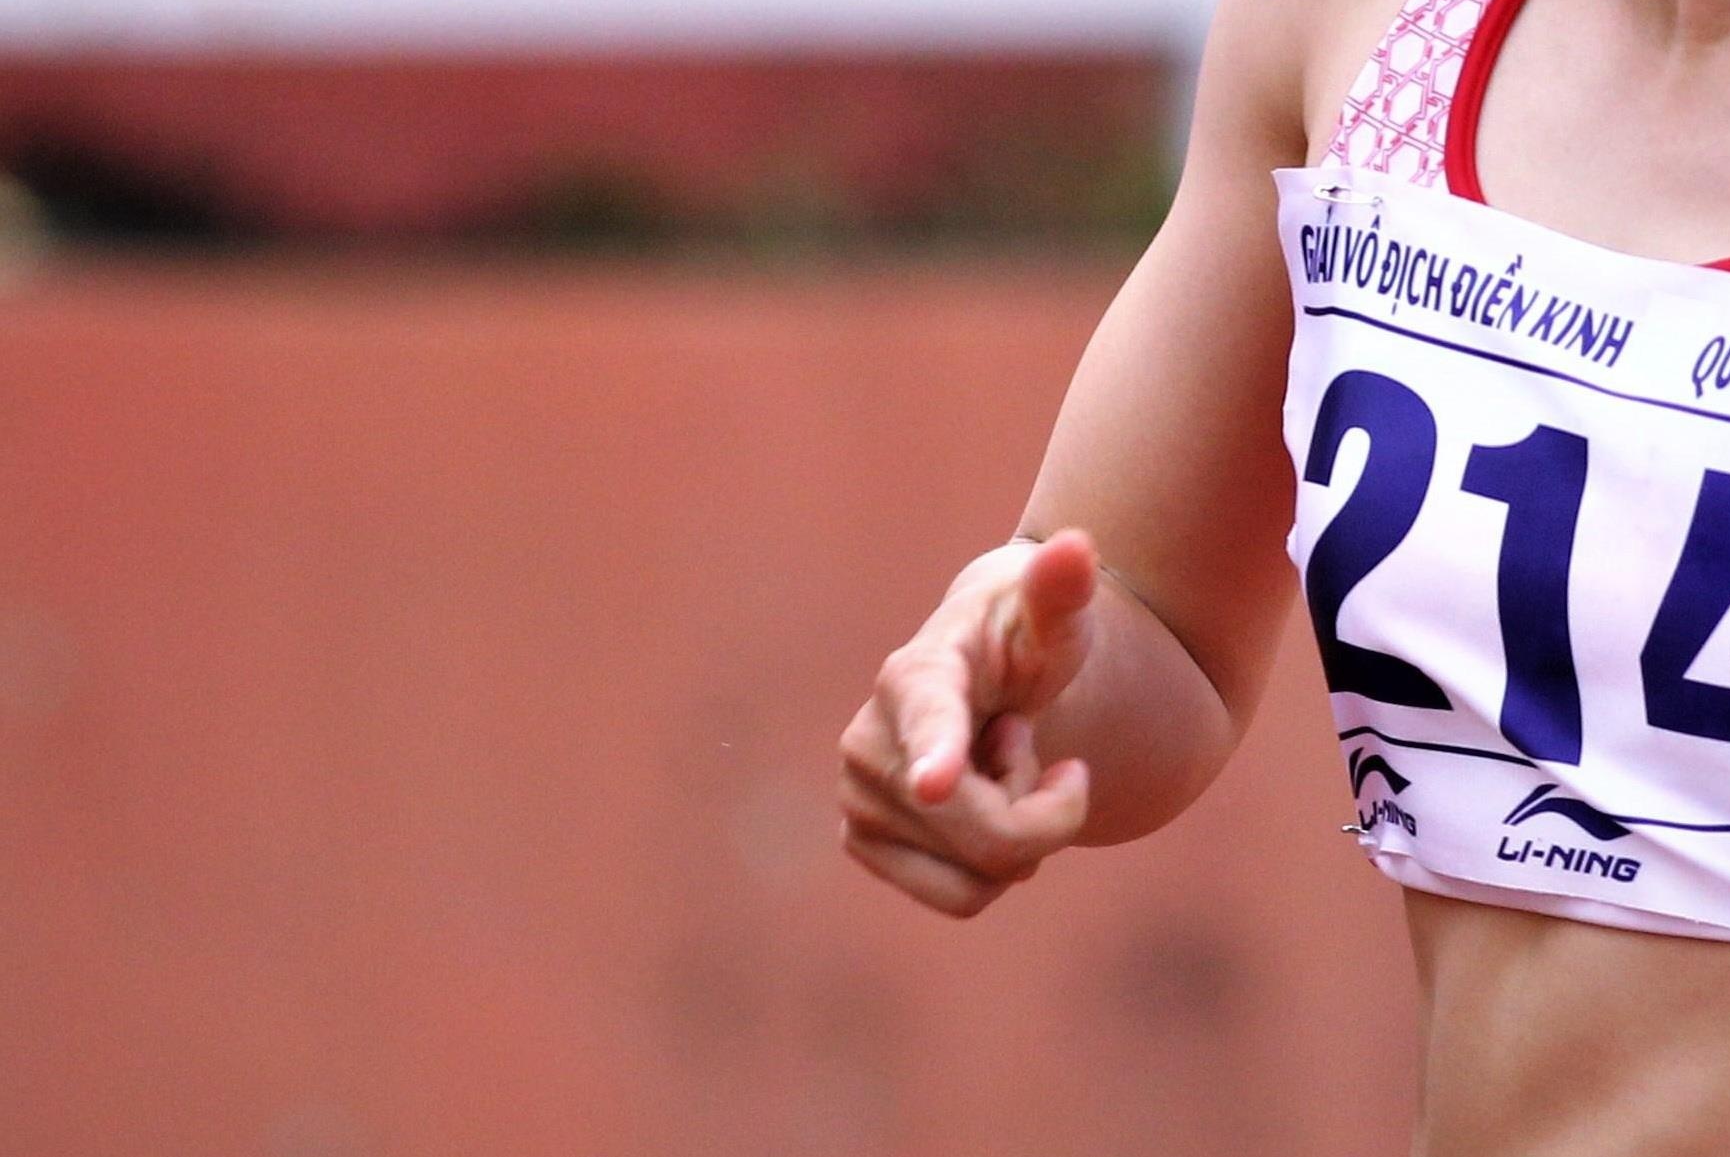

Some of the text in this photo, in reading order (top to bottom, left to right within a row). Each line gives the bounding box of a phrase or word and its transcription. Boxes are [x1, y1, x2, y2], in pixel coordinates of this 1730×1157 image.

[1342, 214, 1379, 288] VÔ
[1377, 240, 1450, 315] ĐỊCH
[1528, 294, 1634, 367] KINH
[1497, 837, 1641, 883] LI-NING
